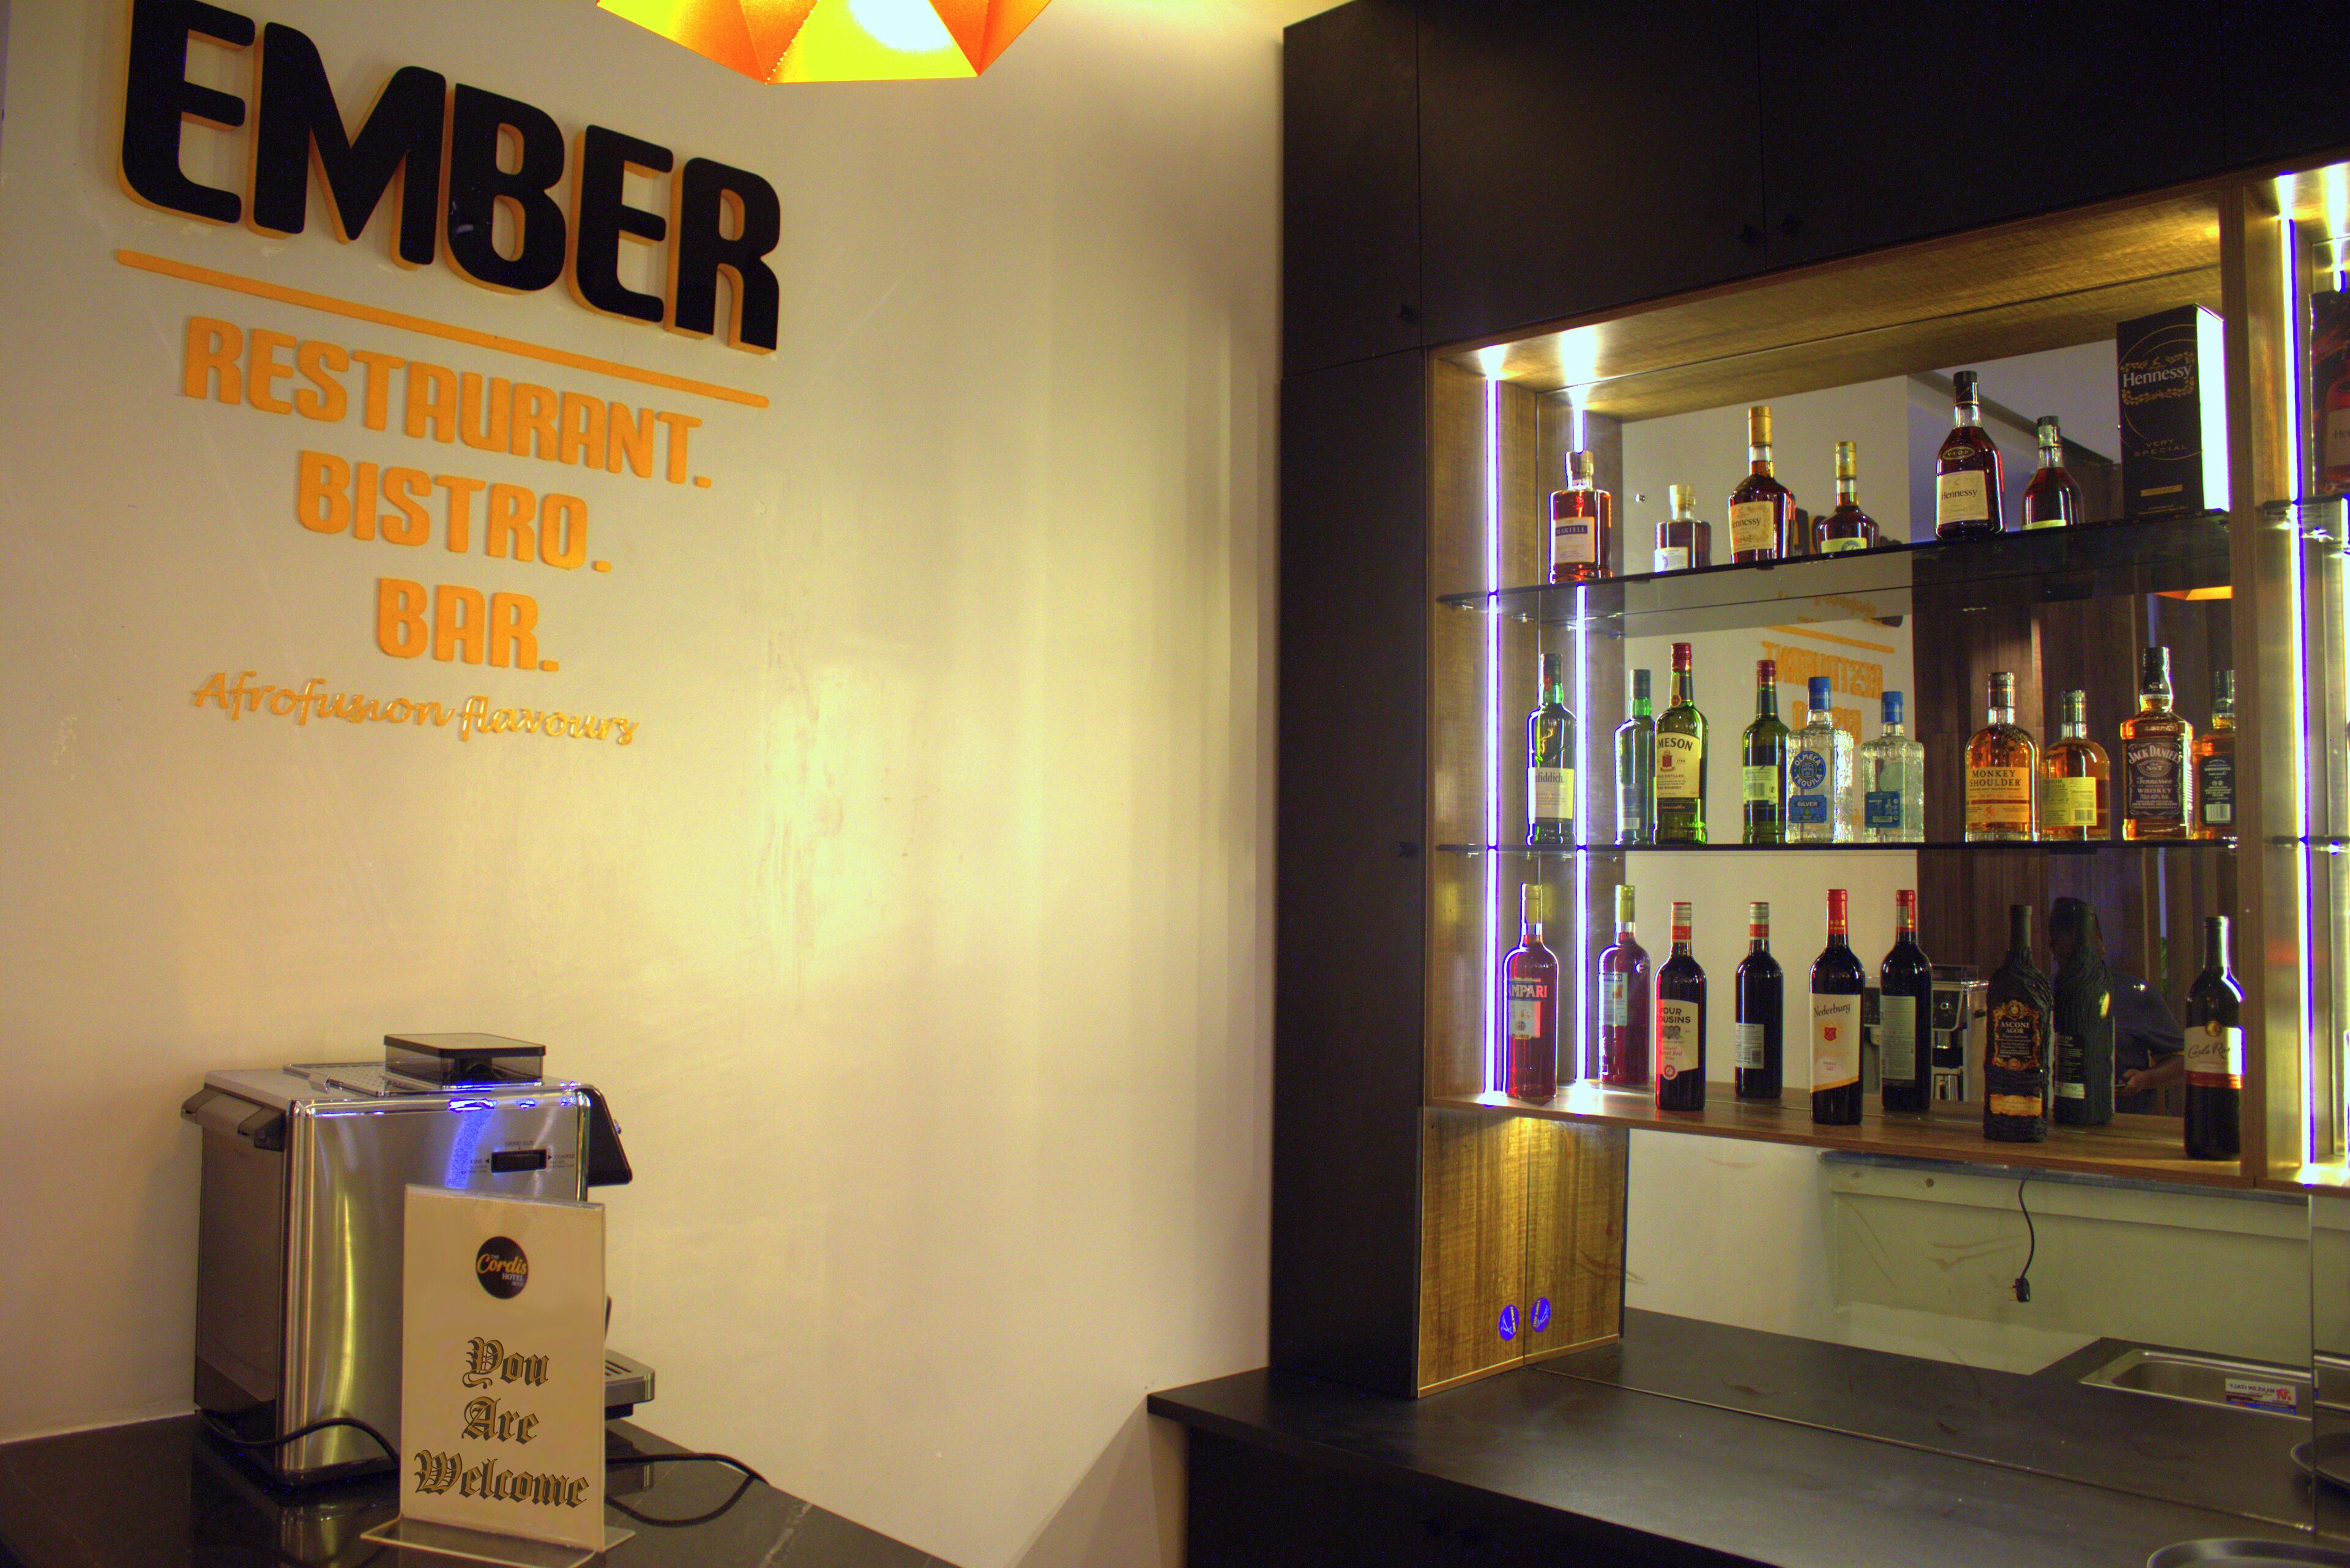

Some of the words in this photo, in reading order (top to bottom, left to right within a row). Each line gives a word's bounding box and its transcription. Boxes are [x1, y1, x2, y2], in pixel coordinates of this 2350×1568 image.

[119, 0, 781, 354] EMBER
[2122, 365, 2191, 387] Hennessy
[182, 315, 712, 488] RESTAURANT.
[2146, 438, 2174, 447] VERY
[1941, 490, 1978, 500] Hennessy
[297, 450, 611, 572] BISTRO.
[1732, 517, 1762, 528] ennessy
[1556, 526, 1586, 535] MARTELL
[378, 577, 559, 672] BAR.
[191, 671, 454, 726] Afrofusion
[460, 696, 640, 745] flavours
[1657, 737, 1693, 752] MESON
[1794, 753, 1823, 766] OLMECA
[2128, 749, 2149, 764] JACK
[2149, 745, 2183, 764] DANIEL'S
[1794, 774, 1822, 787] TEQUILA
[1969, 778, 2021, 787] SHOULDER
[1510, 984, 1548, 998] MPARI
[1660, 1007, 1682, 1015] FOUR
[1813, 1003, 1851, 1018] Nederburg
[477, 1253, 526, 1275] Cordis
[502, 1273, 524, 1282] HOTEL
[462, 1337, 550, 1389] You
[461, 1396, 539, 1444] Are
[414, 1449, 589, 1508] Welcome
